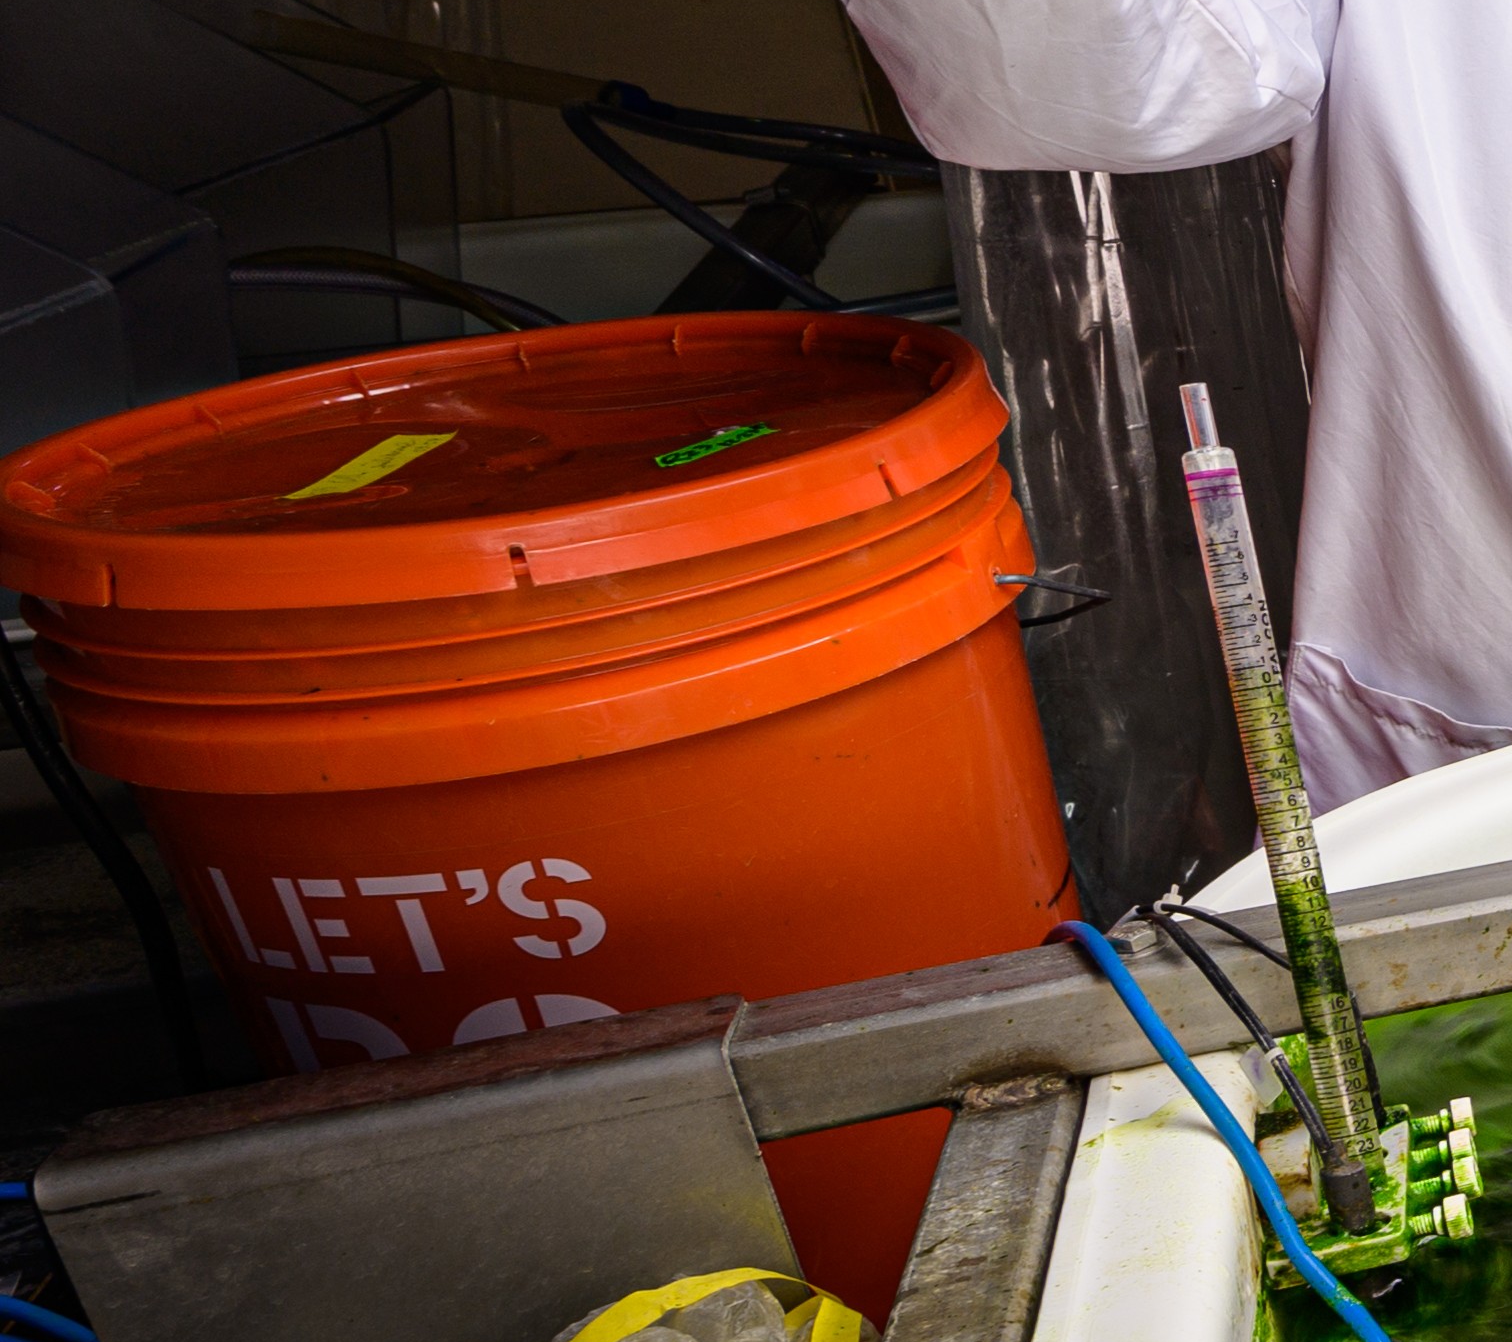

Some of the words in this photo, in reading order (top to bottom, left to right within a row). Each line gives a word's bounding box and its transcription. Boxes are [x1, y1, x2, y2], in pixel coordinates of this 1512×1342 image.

[1262, 671, 1271, 684] 0
[1267, 691, 1274, 703] 1
[1269, 712, 1280, 725] 2
[1274, 733, 1284, 746] 3
[1278, 753, 1288, 765] 4
[1283, 773, 1293, 787] 5
[1287, 794, 1297, 806] 6
[1291, 815, 1300, 828] 7
[1296, 836, 1306, 848] 8
[1301, 856, 1311, 868] 9
[1302, 875, 1319, 889] 10
[1306, 895, 1323, 909] 11
[208, 858, 607, 974] LET'S
[1311, 915, 1327, 929] 12
[1329, 995, 1346, 1010] 16
[1337, 1037, 1354, 1051] 18
[1341, 1057, 1357, 1072] 19
[1345, 1077, 1361, 1092] 20
[1348, 1097, 1365, 1110] 21
[1353, 1118, 1370, 1133] 22
[1356, 1138, 1375, 1153] 23
